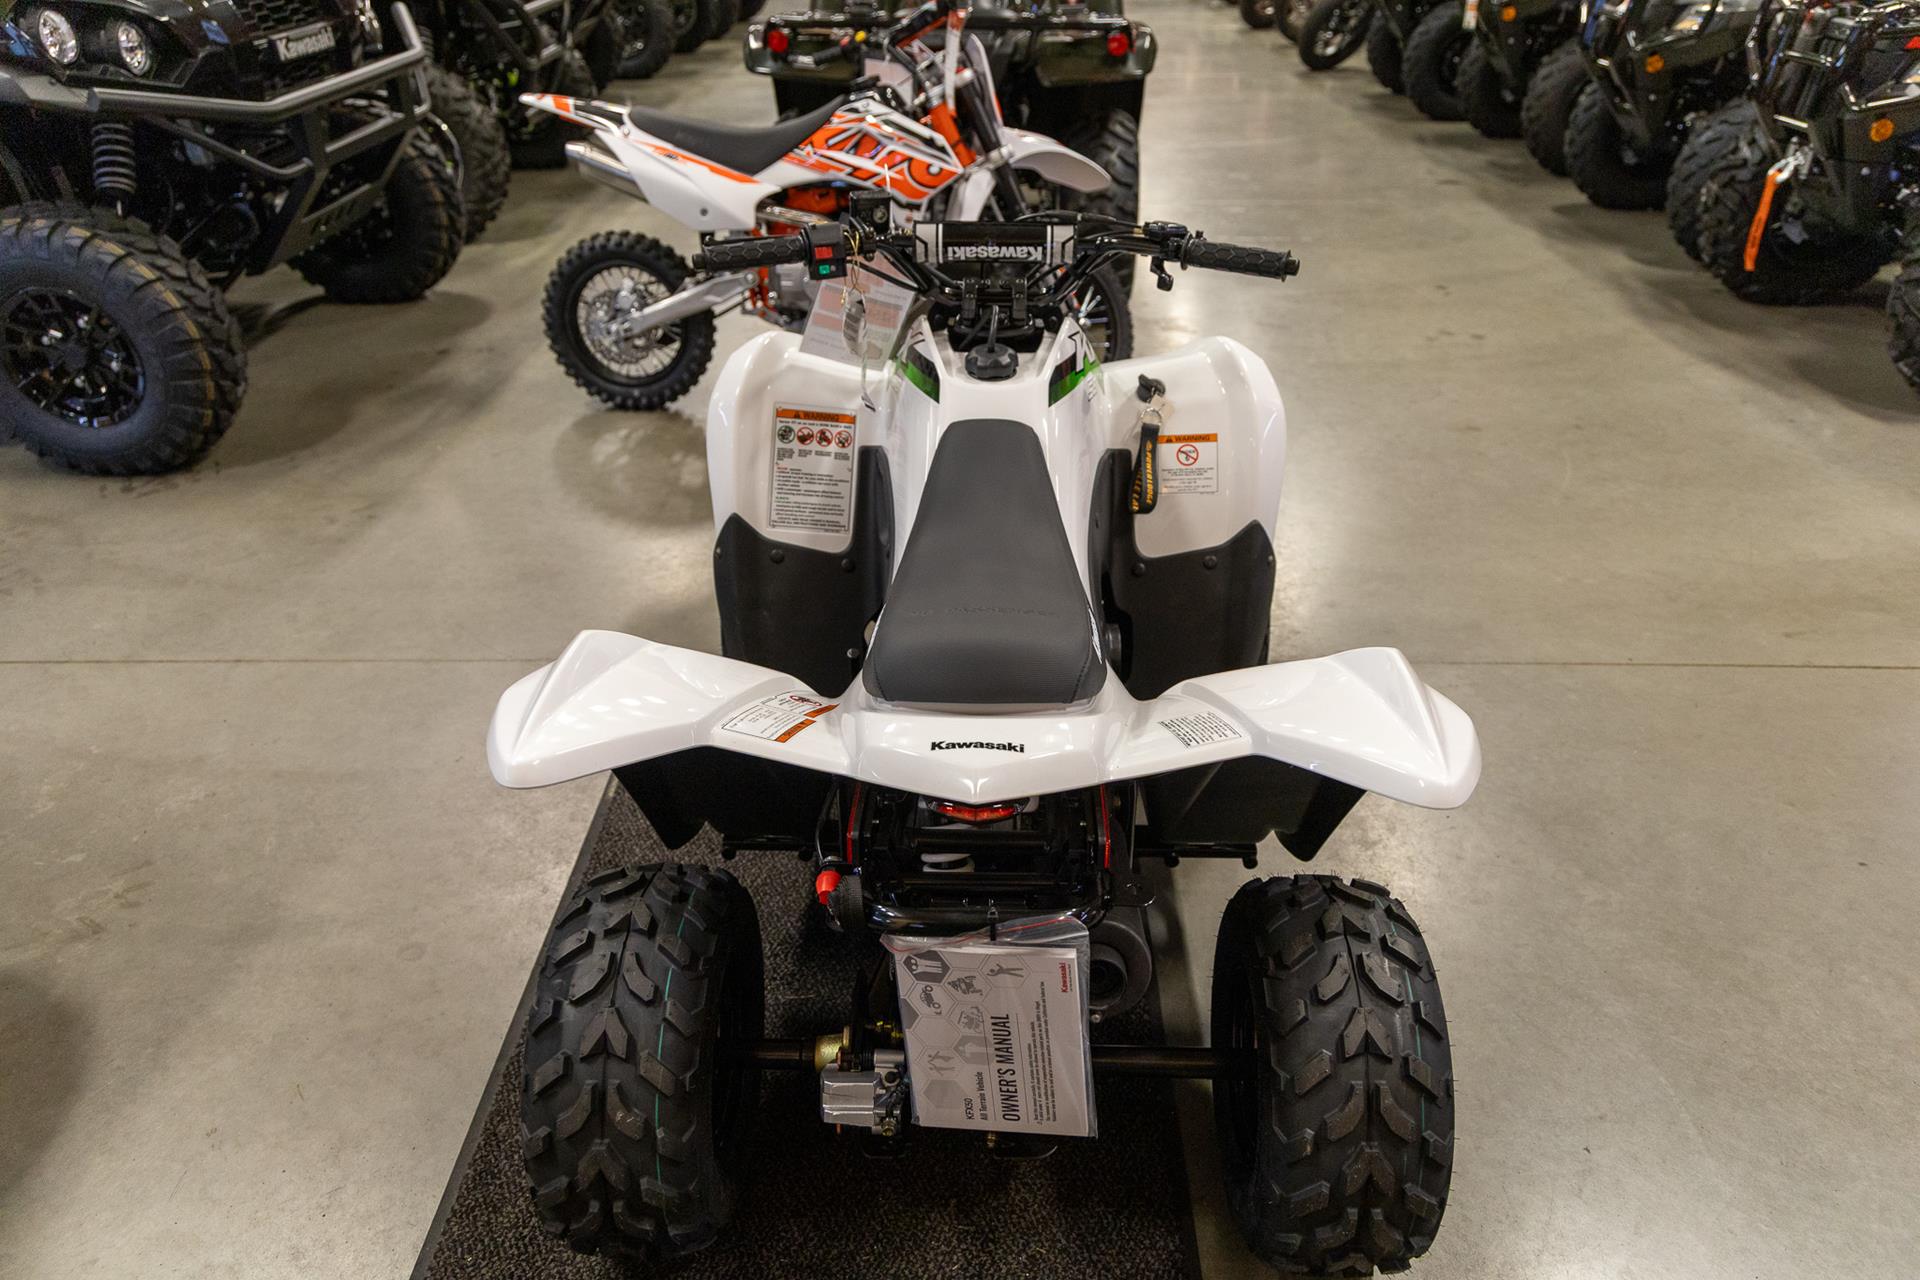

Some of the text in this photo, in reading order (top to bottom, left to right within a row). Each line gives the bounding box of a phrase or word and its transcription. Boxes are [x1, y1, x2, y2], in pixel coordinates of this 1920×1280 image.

[276, 26, 336, 61] Kawasaki
[947, 245, 1043, 261] Kawasaki
[930, 740, 1025, 754] Kawasaki
[1061, 962, 1069, 993] Kawasaki
[990, 1013, 1021, 1122] OWNER'S MANUAL
[976, 1071, 985, 1092] Vehicle
[965, 1097, 974, 1120] KFX50
[978, 1092, 988, 1112] Terrain
